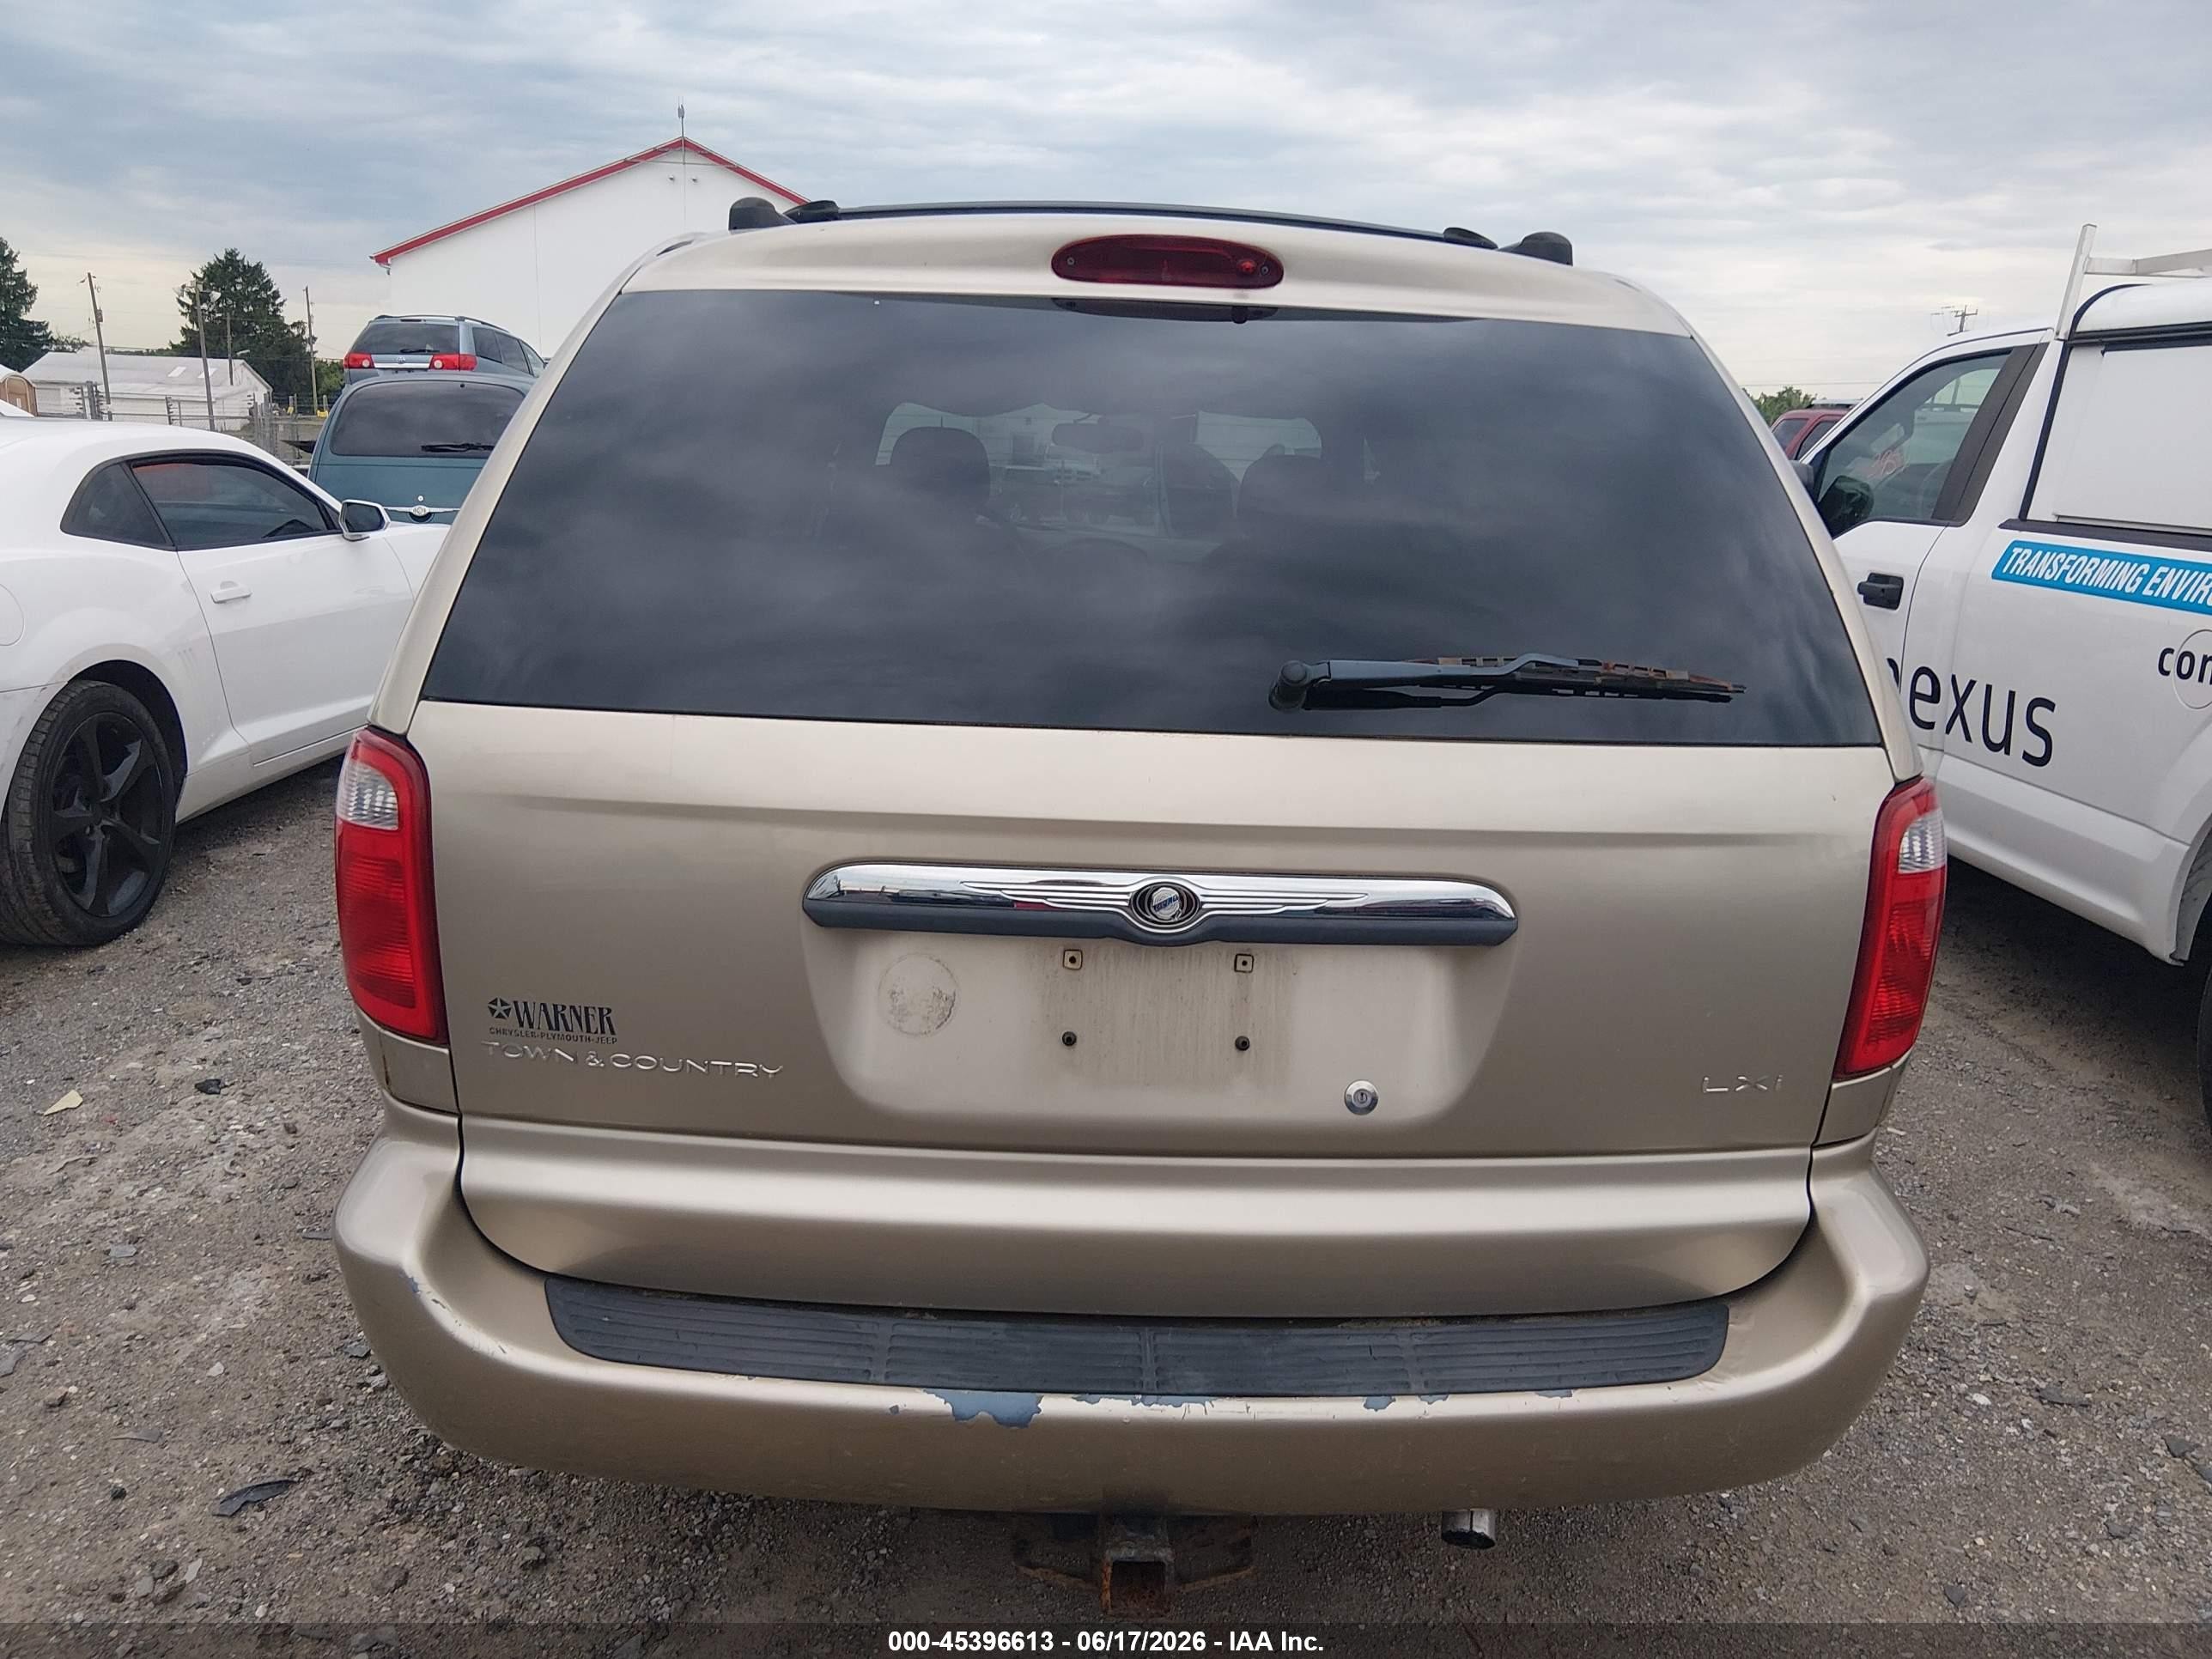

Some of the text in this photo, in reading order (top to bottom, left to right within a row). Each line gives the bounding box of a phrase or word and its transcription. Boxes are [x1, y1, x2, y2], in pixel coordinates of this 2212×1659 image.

[2002, 547, 2150, 593] TRANSFORMING
[513, 1000, 617, 1036] WARNER
[481, 1041, 783, 1078] TOWN & COUNTRY
